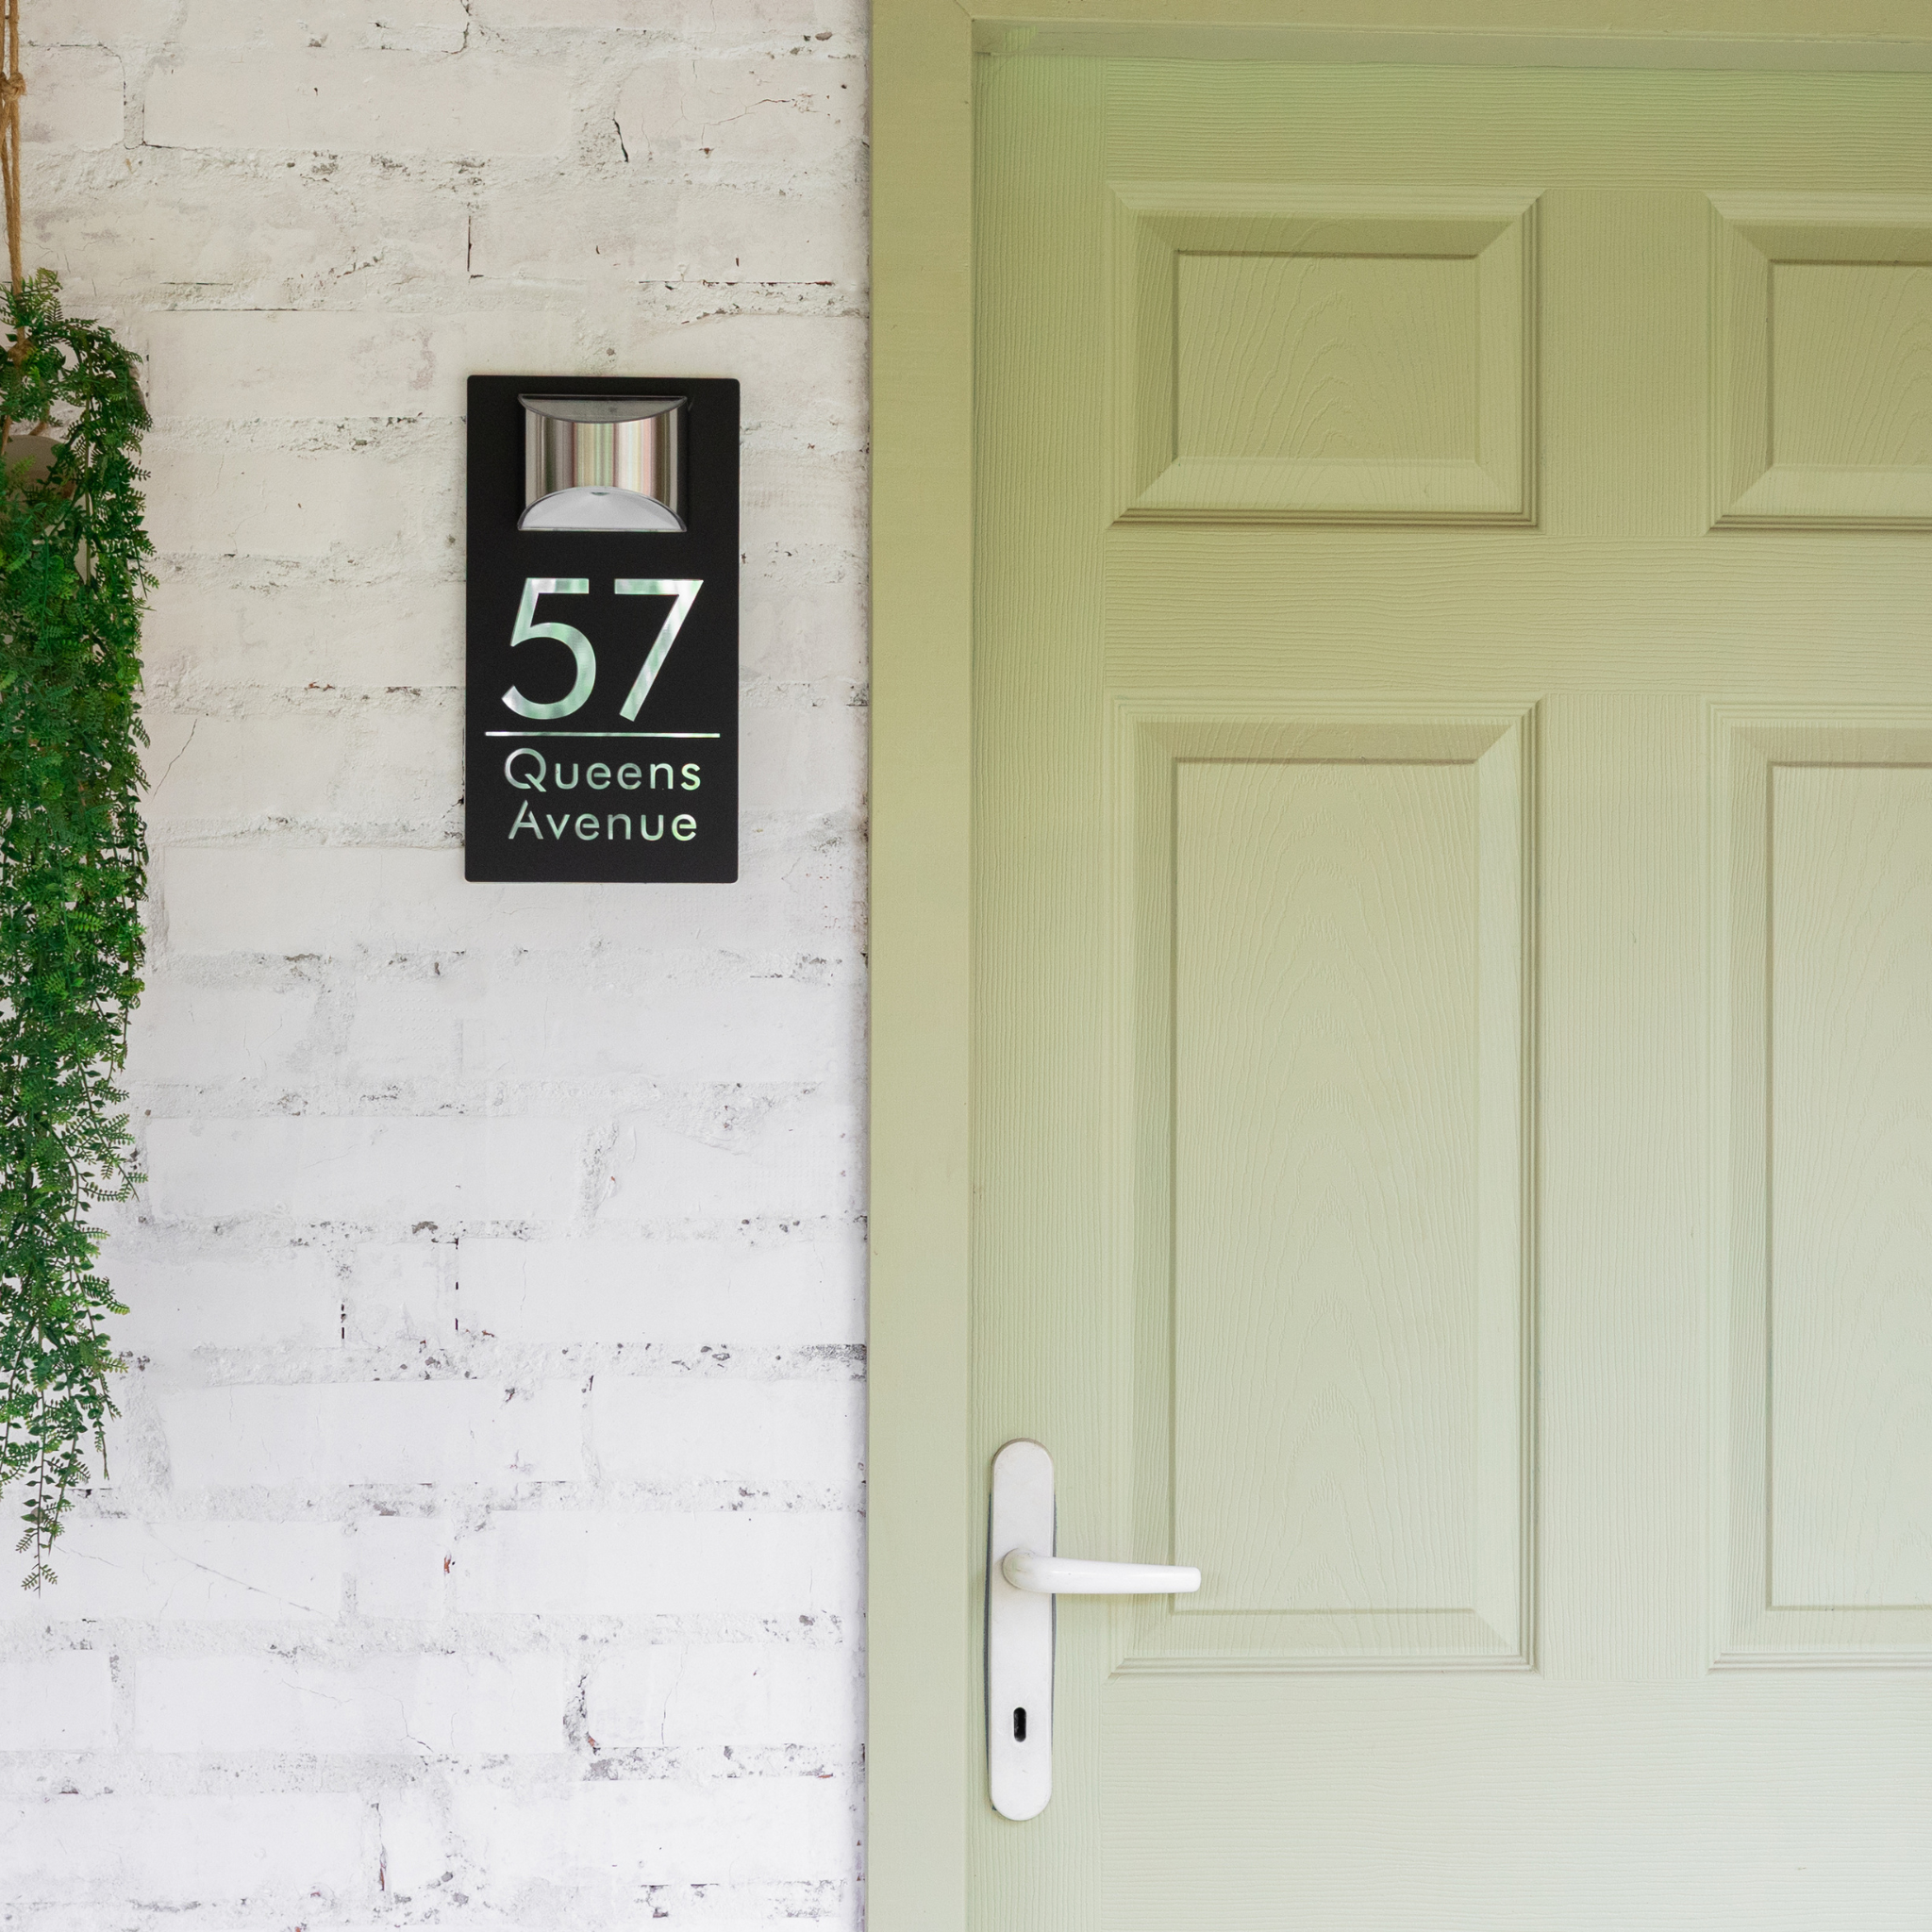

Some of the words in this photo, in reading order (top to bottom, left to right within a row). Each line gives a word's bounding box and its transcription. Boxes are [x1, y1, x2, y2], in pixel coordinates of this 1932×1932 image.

[501, 576, 705, 723] 57
[504, 747, 701, 791] Queens
[508, 799, 697, 841] Avenue
